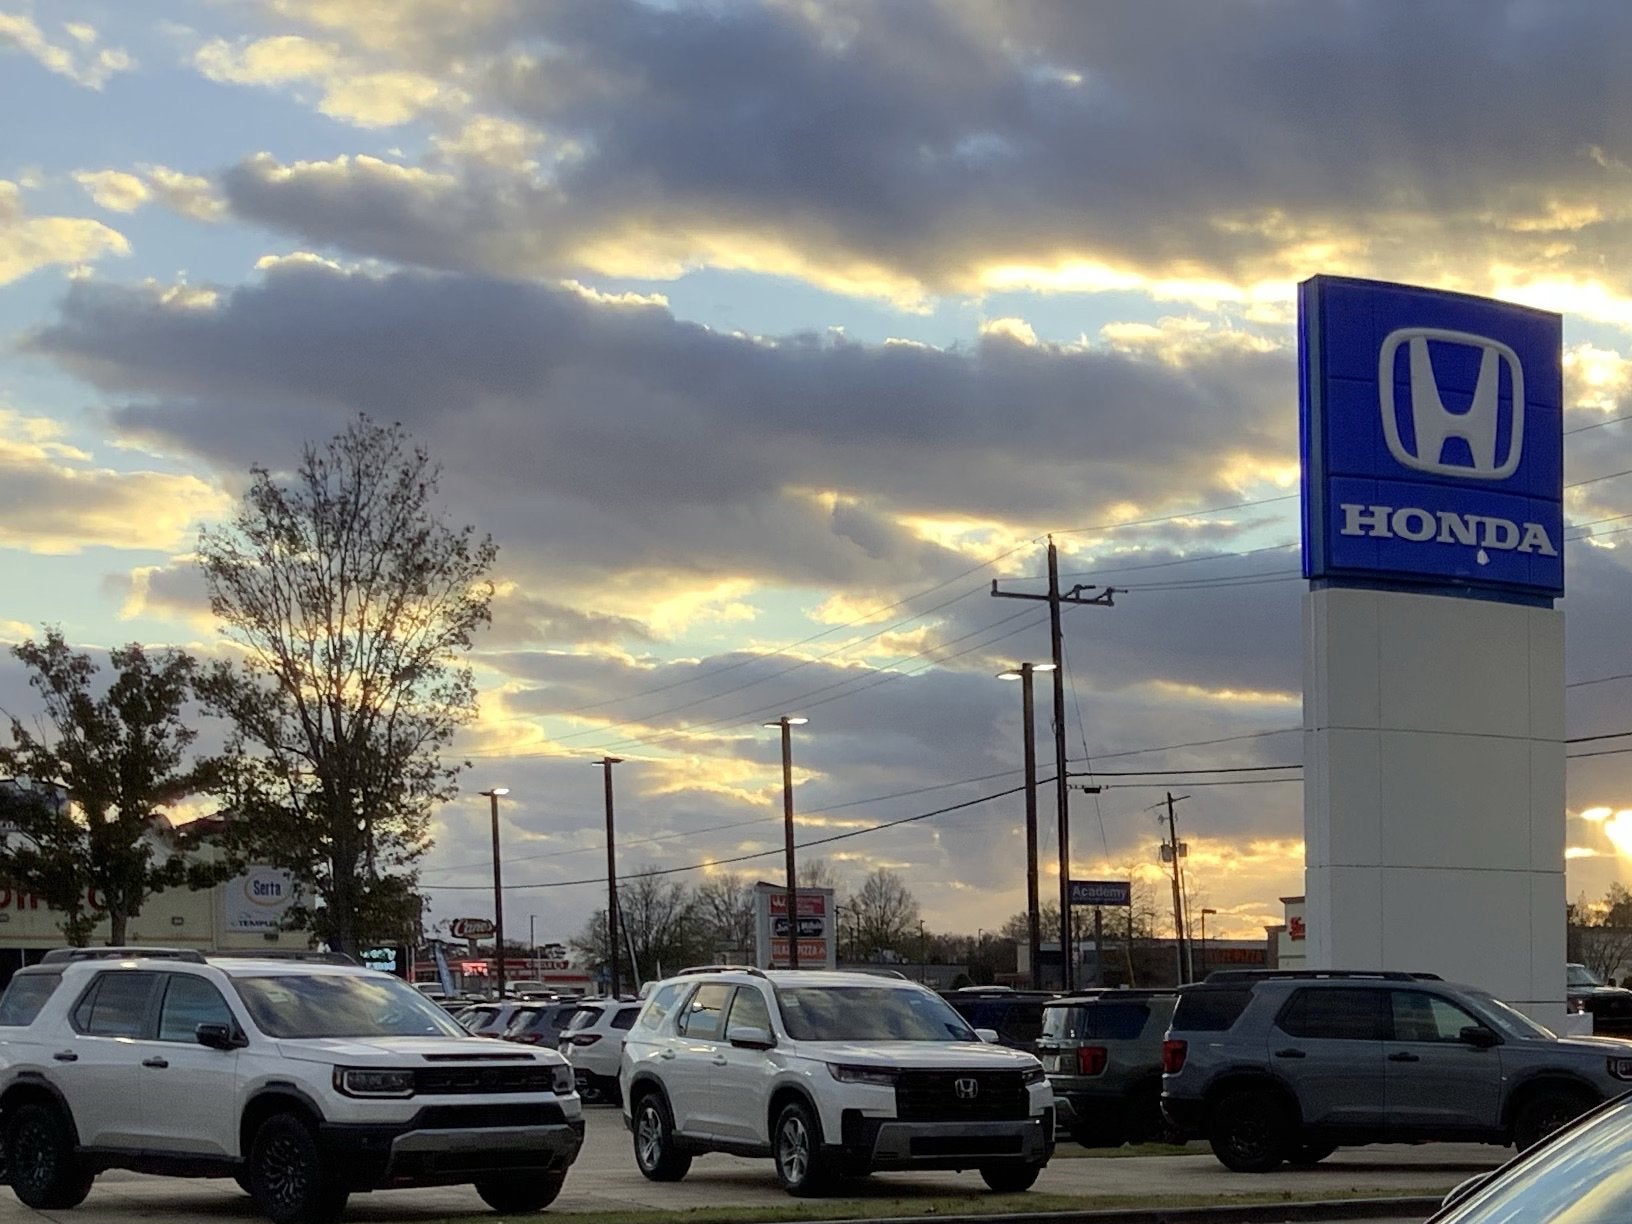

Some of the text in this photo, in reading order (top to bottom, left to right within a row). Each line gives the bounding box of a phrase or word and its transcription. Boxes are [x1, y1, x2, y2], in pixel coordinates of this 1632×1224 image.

[1340, 503, 1558, 557] HONDA
[253, 880, 281, 896] Serta
[1072, 885, 1128, 901] Academy
